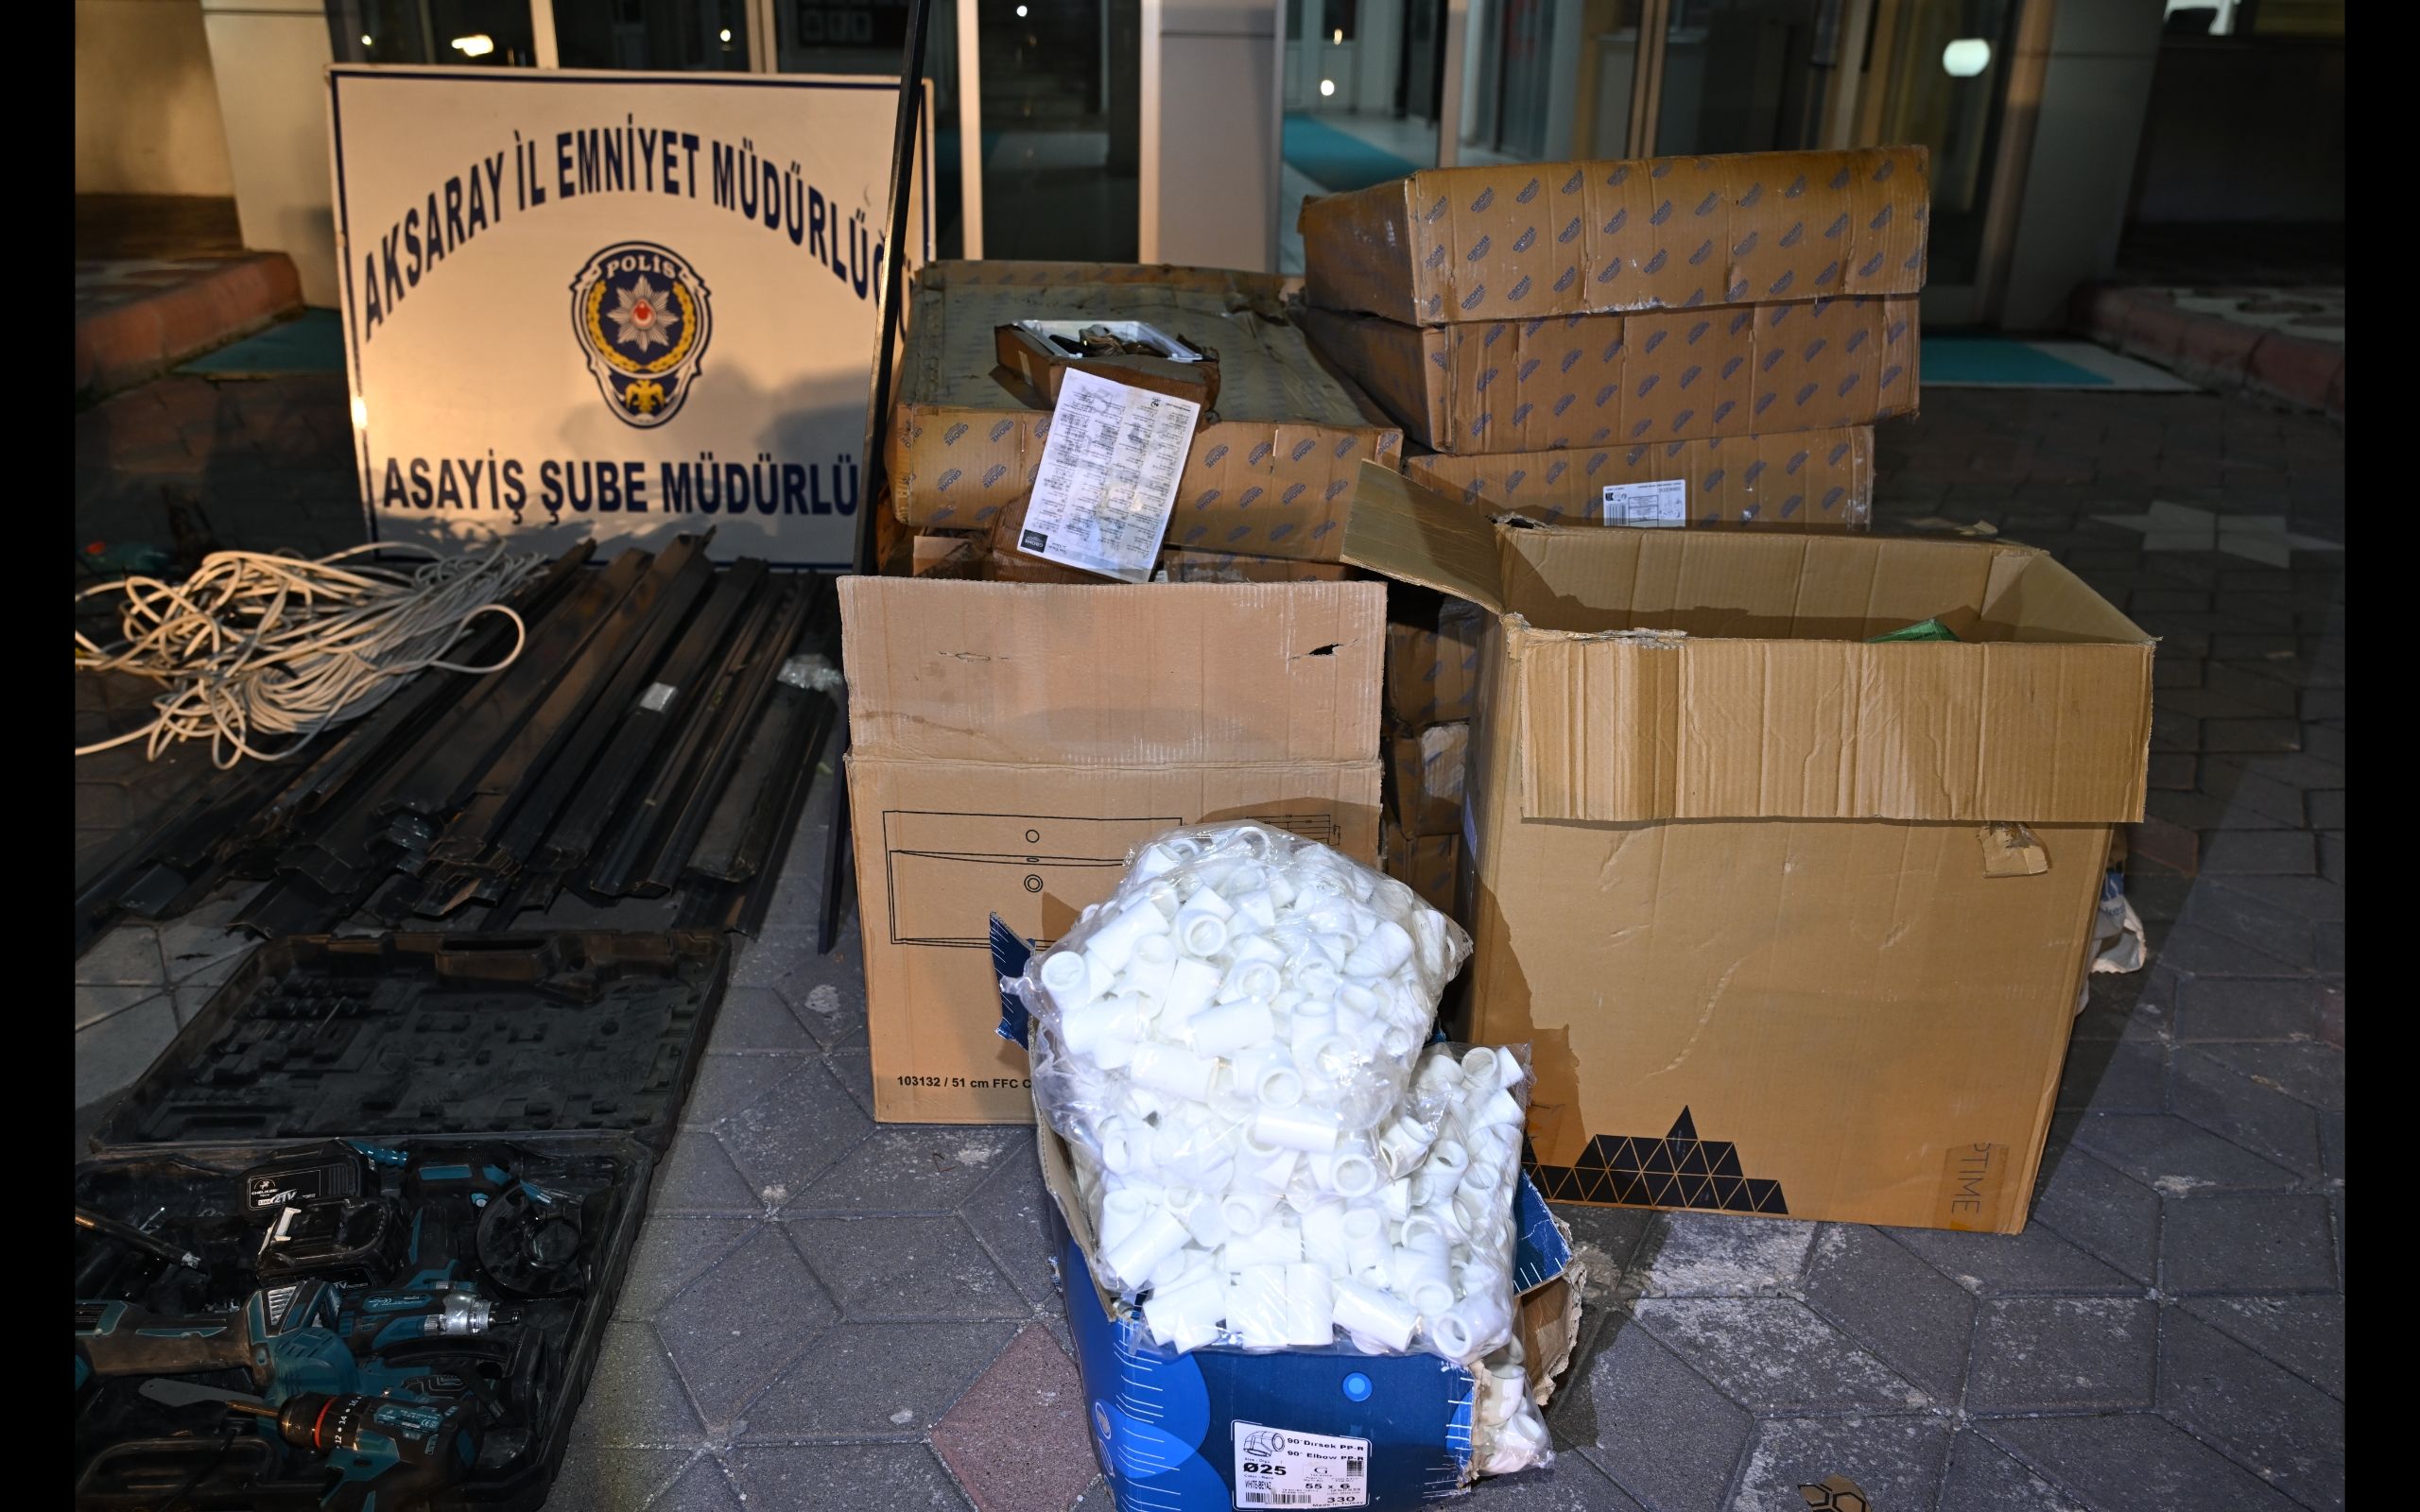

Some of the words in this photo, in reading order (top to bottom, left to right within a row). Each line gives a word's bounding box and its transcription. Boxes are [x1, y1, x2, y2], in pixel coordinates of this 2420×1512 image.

[365, 151, 505, 342] AKSARAY
[514, 129, 545, 211] İL
[557, 112, 700, 198] EMNİYET
[712, 137, 915, 343] MÜDÜRLÜ
[606, 255, 676, 280] POLİS
[945, 423, 969, 447] GROHE
[991, 421, 1014, 444] GROHE
[1204, 445, 1229, 469] GROHE
[383, 449, 527, 525] ASAYİŞ
[541, 461, 648, 525] ŞUBE
[938, 469, 962, 492] GROHE
[982, 465, 1007, 489] GROHE
[897, 1076, 941, 1088] 103132
[943, 1077, 949, 1088] /
[952, 1077, 966, 1088] 51
[970, 1079, 990, 1089] cm
[993, 1078, 1019, 1089] FFC
[1243, 1462, 1287, 1476] Ø25
